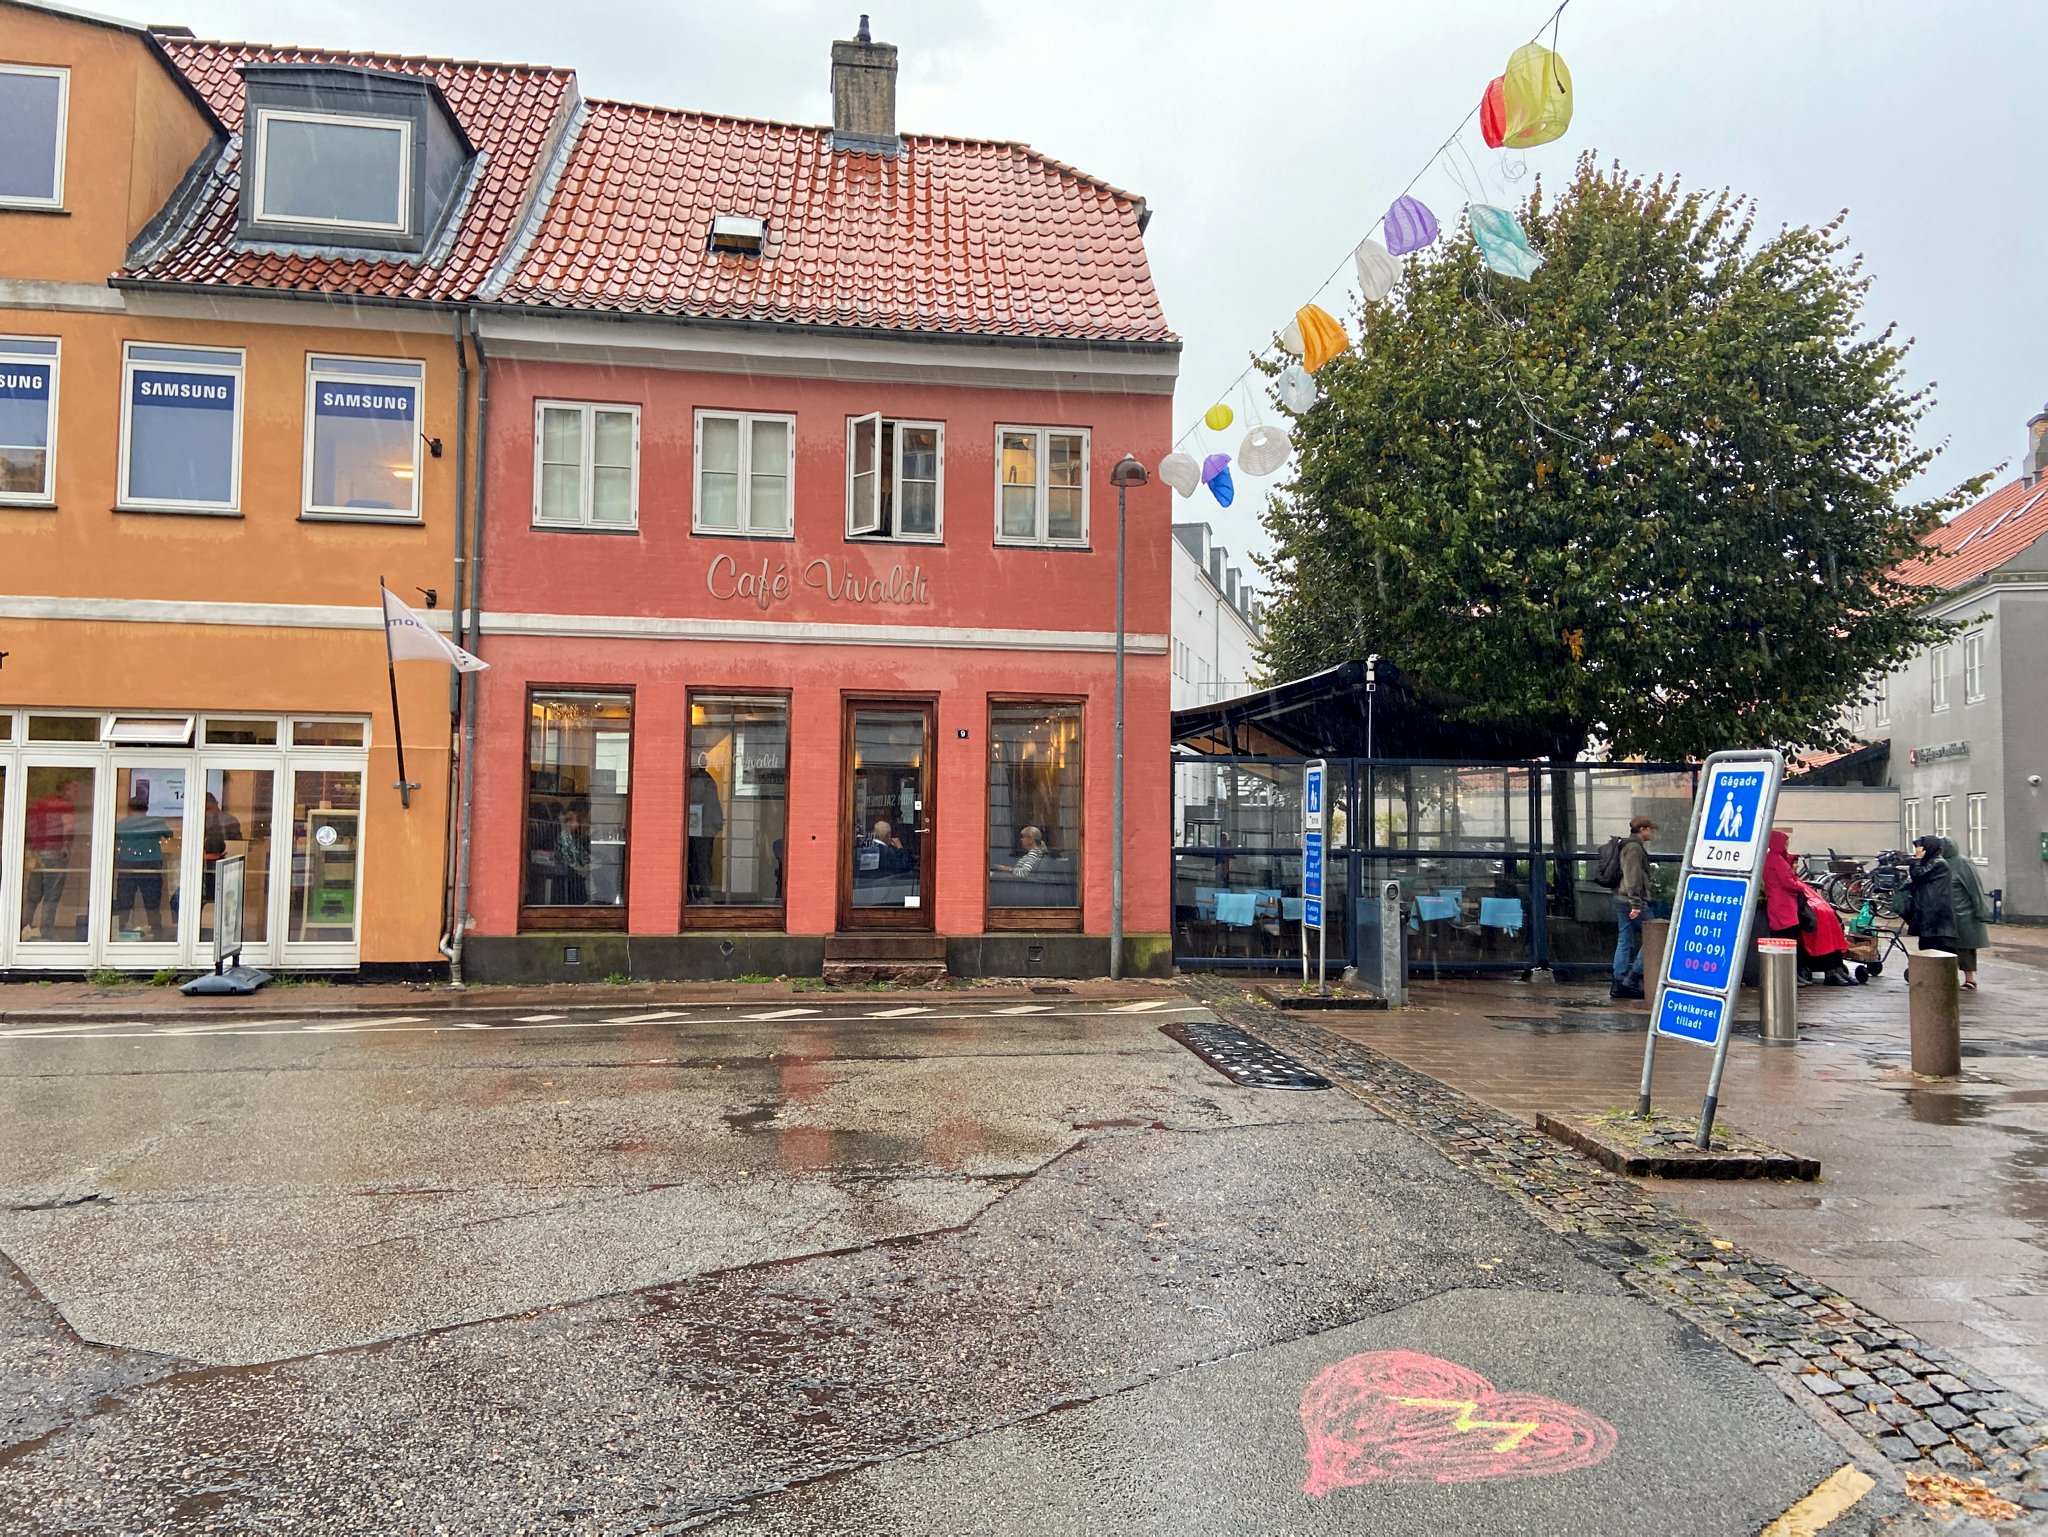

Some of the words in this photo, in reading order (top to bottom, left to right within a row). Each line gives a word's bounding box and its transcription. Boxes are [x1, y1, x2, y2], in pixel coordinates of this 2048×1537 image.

[141, 381, 227, 400] SAMSUNG
[323, 392, 408, 410] SAMSUNG
[707, 553, 789, 610] Café
[804, 558, 930, 605] Vivaldi
[733, 752, 779, 769] Vivaldi
[1720, 775, 1758, 789] Gågade
[1706, 845, 1740, 862] Zone
[1687, 889, 1744, 906] Varekørsel
[1694, 908, 1728, 922] tilladt
[1694, 924, 1722, 939] 00-11
[1684, 940, 1725, 958] (00-09)
[1685, 957, 1718, 973] 00-09
[1667, 999, 1717, 1019] Cykelkørsel
[1676, 1015, 1703, 1030] tilladt
